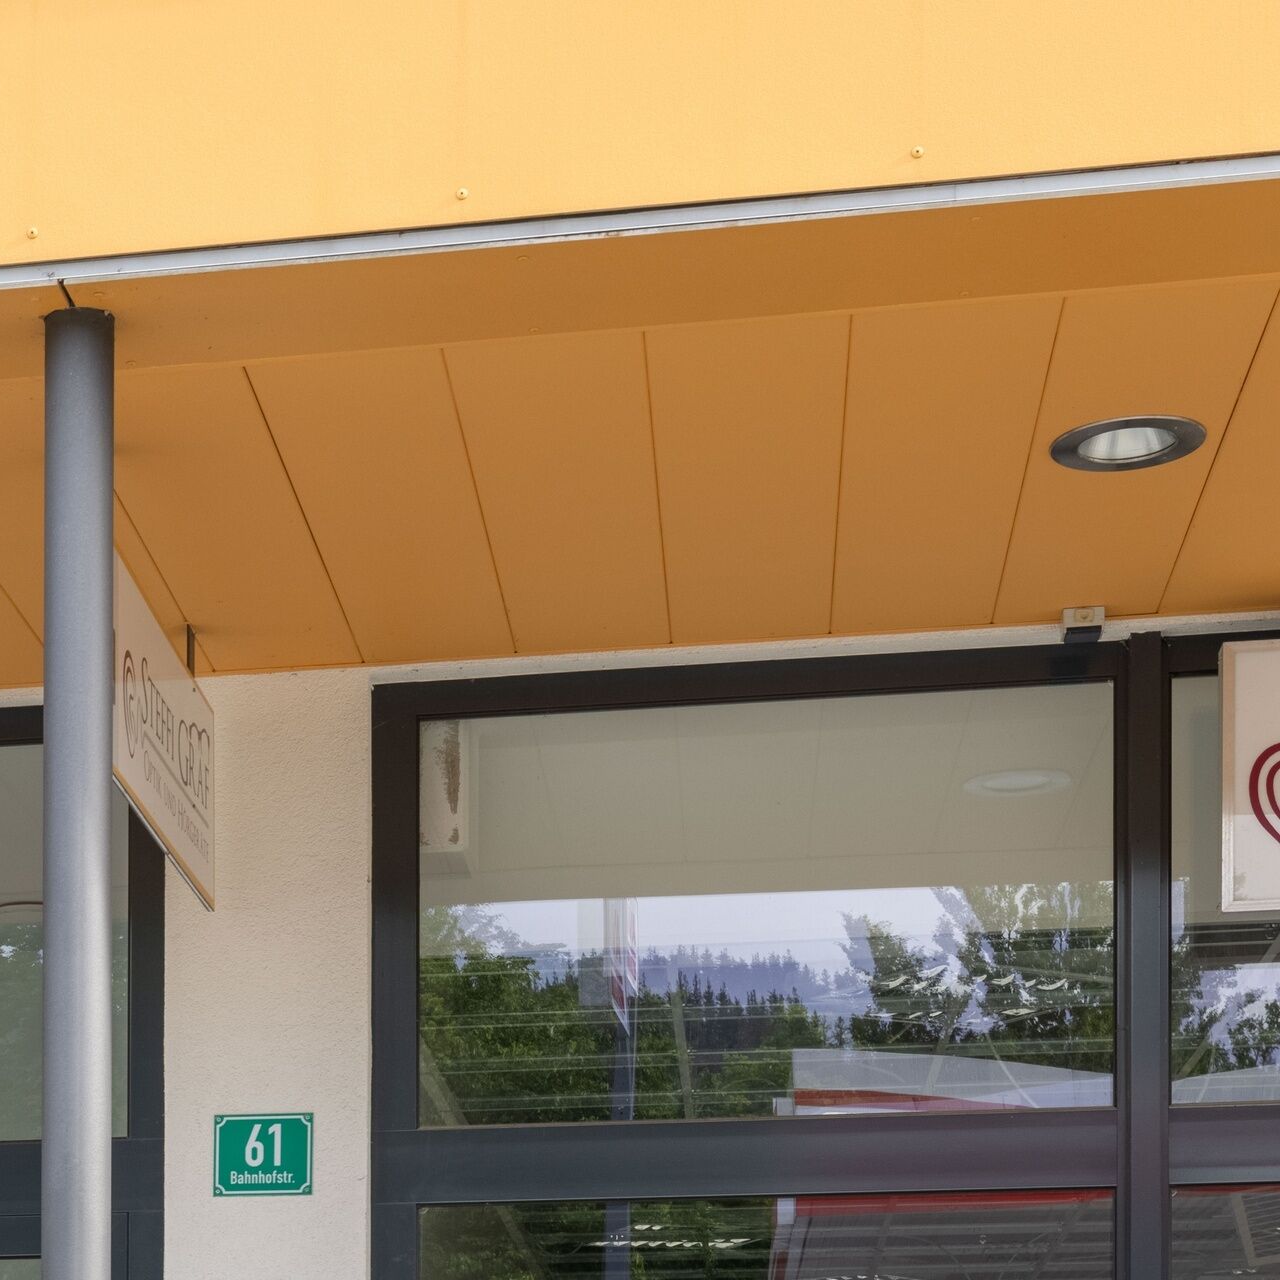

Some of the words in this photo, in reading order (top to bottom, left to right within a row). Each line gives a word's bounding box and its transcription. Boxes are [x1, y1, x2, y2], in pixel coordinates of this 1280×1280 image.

[178, 719, 210, 809] GRAF
[245, 1123, 282, 1167] 61
[230, 1171, 295, 1185] Bahnhofstr.
